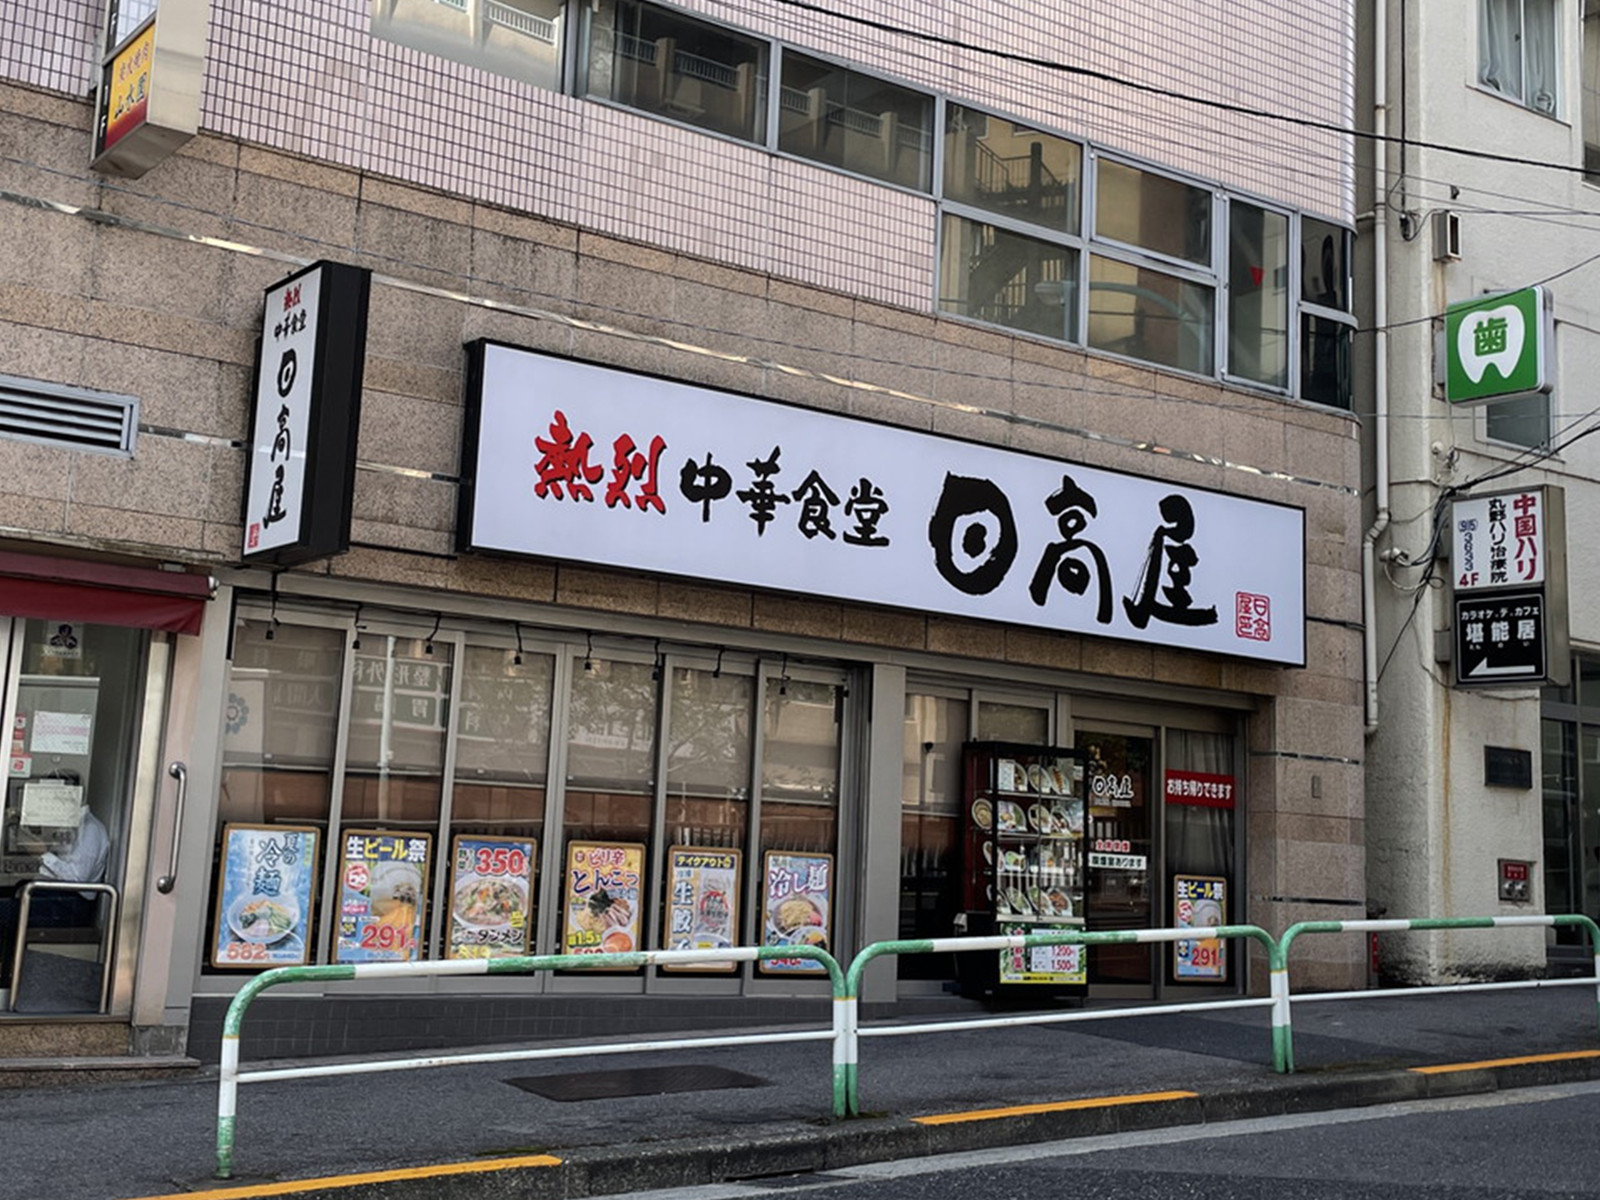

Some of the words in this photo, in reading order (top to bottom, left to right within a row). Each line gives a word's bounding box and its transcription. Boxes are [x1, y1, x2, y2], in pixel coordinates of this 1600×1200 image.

[1474, 316, 1508, 356] 歯
[262, 348, 296, 529] 日高屋
[533, 409, 668, 515] 熱烈
[679, 445, 891, 547] 中華食堂
[927, 470, 1219, 630] 日高屋
[1513, 493, 1538, 581] 中国ハリ
[1458, 572, 1479, 587] 4F
[1166, 777, 1233, 800] お持ち帰りできます
[345, 835, 427, 862] 生ビール祭
